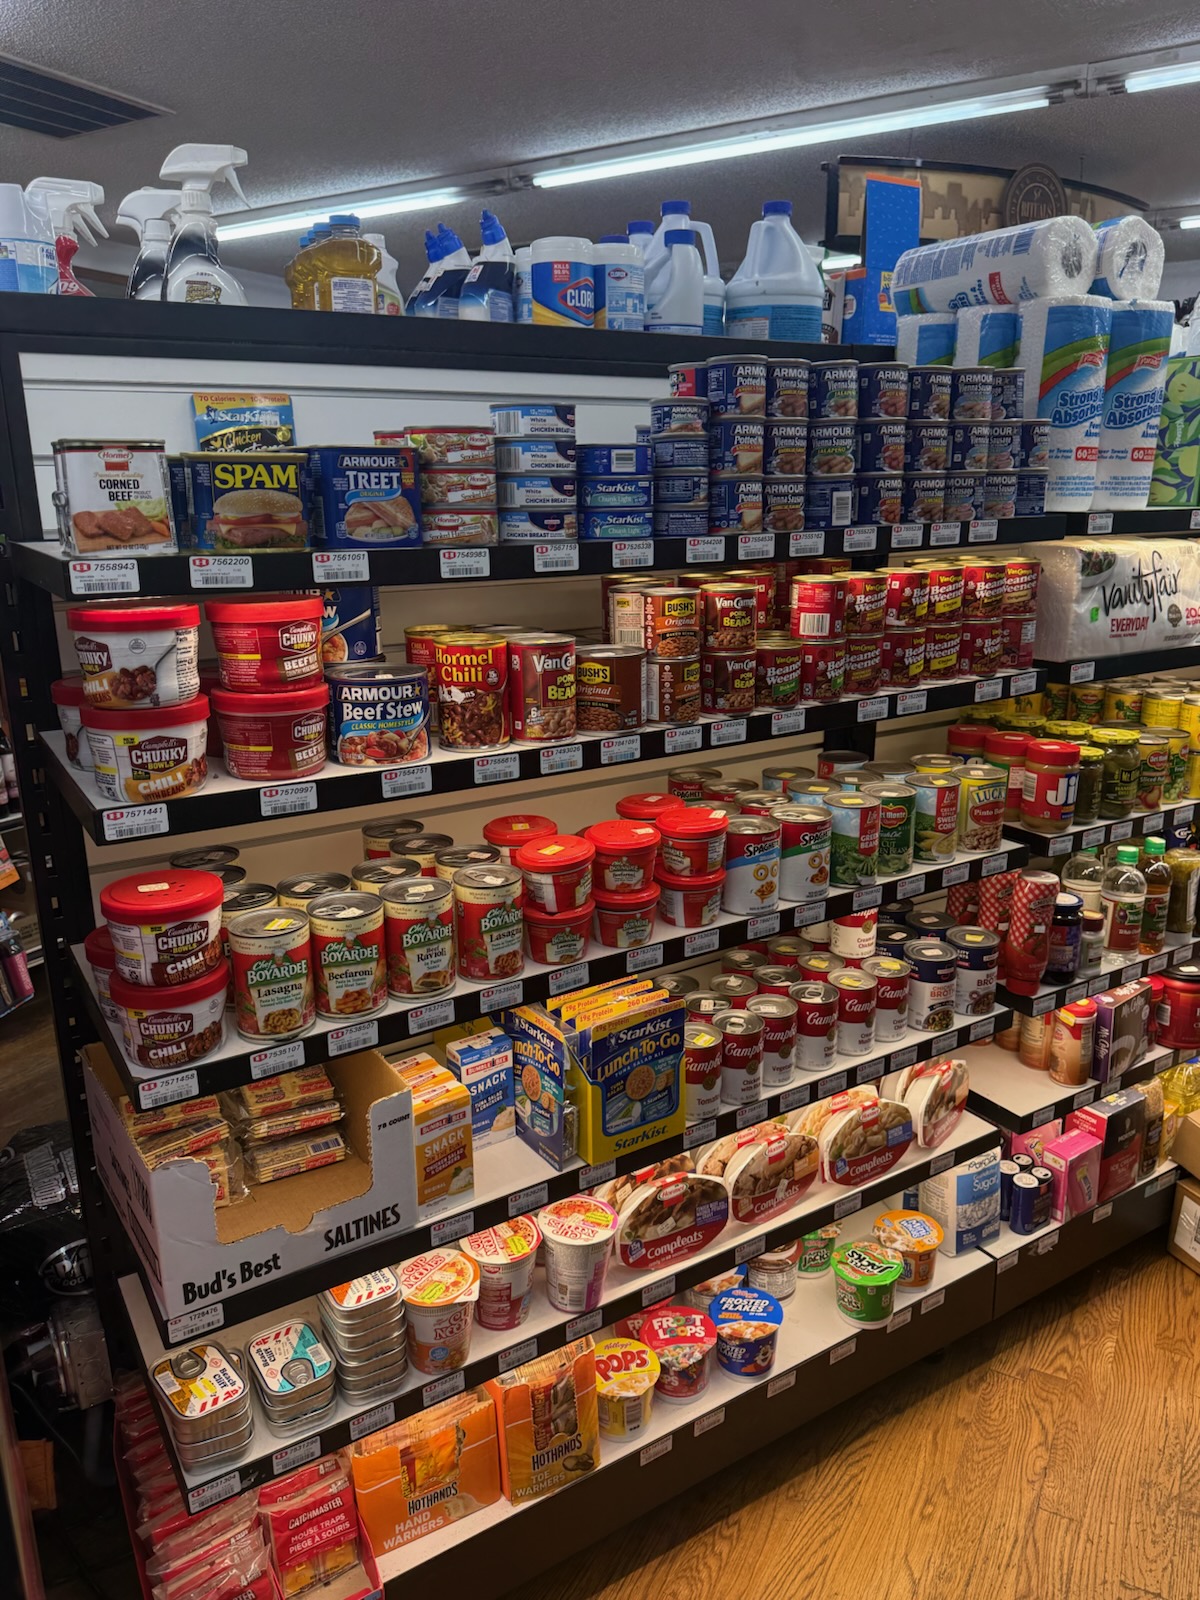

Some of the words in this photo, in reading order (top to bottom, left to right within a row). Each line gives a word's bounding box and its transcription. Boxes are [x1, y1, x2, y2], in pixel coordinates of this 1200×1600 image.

[1114, 392, 1155, 408] Strong
[1106, 404, 1161, 425] Absorbe
[811, 427, 850, 437] ARMOUR
[223, 431, 261, 449] Chicken
[812, 438, 831, 447] Vienna
[103, 451, 130, 460] Hormel
[343, 457, 396, 467] ARMOUR
[214, 464, 298, 489] SPAM
[345, 471, 400, 489] TREET
[99, 479, 139, 491] CORNED
[596, 484, 636, 492] StarKist
[765, 485, 804, 493] ARMOUR
[109, 491, 133, 501] BEEF
[436, 515, 460, 524] Hormel
[607, 515, 644, 524] StarKist
[429, 532, 450, 540] Smoked
[450, 529, 467, 537] Ham
[94, 562, 135, 571] 7558943
[667, 601, 694, 614] BUSH'S
[665, 617, 695, 626] Original
[723, 618, 750, 627] BEANS
[1111, 617, 1149, 632] EVERYDAY
[283, 631, 317, 647] CHUNKY
[436, 648, 493, 665] Hormel
[284, 658, 307, 671] BEEF
[441, 666, 483, 683] Chili
[577, 665, 608, 680] BUSH'S
[341, 684, 414, 701] ARMOUR
[577, 684, 611, 696] Original
[343, 702, 383, 721] Beef
[386, 701, 423, 719] Stew
[294, 721, 324, 739] CHUNKY
[351, 721, 377, 730] CLASSIC
[378, 718, 414, 729] HOMESTYLE
[141, 738, 178, 750] Campbell's
[131, 746, 186, 764] CHUNKY
[295, 748, 315, 762] BEEF
[148, 759, 174, 770] BOWLS
[399, 768, 428, 777] 7554751
[138, 776, 183, 793] CHILI
[161, 783, 186, 797] BEANS
[280, 786, 314, 796] 7570997
[125, 807, 163, 818] 7571441
[886, 811, 906, 819] Monte
[937, 815, 957, 824] SWEET
[974, 808, 991, 816] Pinto
[938, 822, 956, 831] CORN
[860, 833, 879, 842] GREEN
[486, 909, 503, 918] Chef
[166, 922, 202, 936] Campbell's
[402, 923, 453, 947] BOYARDEE
[408, 924, 425, 934] Chef
[158, 928, 209, 949] CHUNKY
[326, 941, 343, 951] Chef
[172, 943, 197, 954] BOWLS
[320, 945, 378, 965] BOYARDEE
[417, 949, 447, 962] Ravioli
[166, 952, 204, 974] CHILI
[189, 964, 207, 976] SPICY
[253, 959, 272, 971] Chef
[247, 960, 308, 986] BOYARDEE
[328, 967, 373, 981] Beefaroni
[257, 982, 303, 999] Lasagna
[579, 1014, 591, 1022] 19g
[592, 1007, 613, 1018] Protein
[628, 998, 640, 1008] 260
[641, 993, 665, 1005] Calories
[140, 1018, 191, 1035] CHUNKY
[147, 1014, 181, 1024] Campbell's
[345, 1022, 375, 1035] 7538507
[520, 1019, 555, 1051] StarKist
[619, 1017, 672, 1043] StarKist
[154, 1032, 179, 1041] BOWLS
[149, 1042, 186, 1059] CHILI
[268, 1045, 300, 1059] 7535107
[597, 1032, 680, 1082] Lunch-To-Go
[466, 1062, 492, 1076] BUMBLE
[496, 1055, 509, 1066] BEE
[615, 1065, 631, 1077] TUNA
[633, 1057, 653, 1070] SALAD
[655, 1051, 665, 1059] KIT
[160, 1073, 195, 1088] 7571458
[470, 1071, 507, 1096] SNACK
[388, 1113, 411, 1128] COUNT
[861, 1108, 879, 1120] Hormel
[421, 1121, 447, 1136] BUMBLE
[453, 1111, 467, 1122] BEE
[424, 1128, 465, 1158] SNACK
[613, 1124, 668, 1152] StarKist
[767, 1140, 787, 1156] Hormel
[426, 1158, 447, 1173] CHICKEN
[850, 1151, 893, 1176] Compleats
[424, 1182, 446, 1194] ORIGINAL
[973, 1175, 999, 1192] Sugar
[660, 1184, 686, 1199] Hormel
[323, 1203, 401, 1252] SALTINES
[647, 1231, 703, 1259] Compleats
[402, 1256, 426, 1276] CUP
[802, 1251, 830, 1269] JACKS
[403, 1254, 445, 1288] NOODLES
[183, 1268, 237, 1306] Bud's
[239, 1254, 282, 1284] Best
[719, 1297, 769, 1308] FROSTED
[189, 1306, 219, 1322] 1728476
[652, 1315, 704, 1330] FROOT
[657, 1327, 705, 1339] LOOPS
[604, 1341, 632, 1351] Kellogg's
[256, 1347, 269, 1368] Beach
[596, 1350, 649, 1382] POPS
[219, 1368, 237, 1388] Beach
[364, 1405, 392, 1420] 7531312
[532, 1434, 583, 1471] HOTHANDS
[204, 1474, 236, 1492] 7531304
[515, 1472, 566, 1498] WARMERS
[531, 1471, 550, 1484] TOE
[408, 1482, 458, 1516] HOTHANDS
[288, 1496, 343, 1530] CATCHMASTER
[291, 1527, 318, 1544] MOUSE
[319, 1514, 346, 1529] TRAPS
[394, 1511, 431, 1534] HAND
[322, 1521, 350, 1540] SOURIS
[383, 1516, 444, 1550] WARMERS
